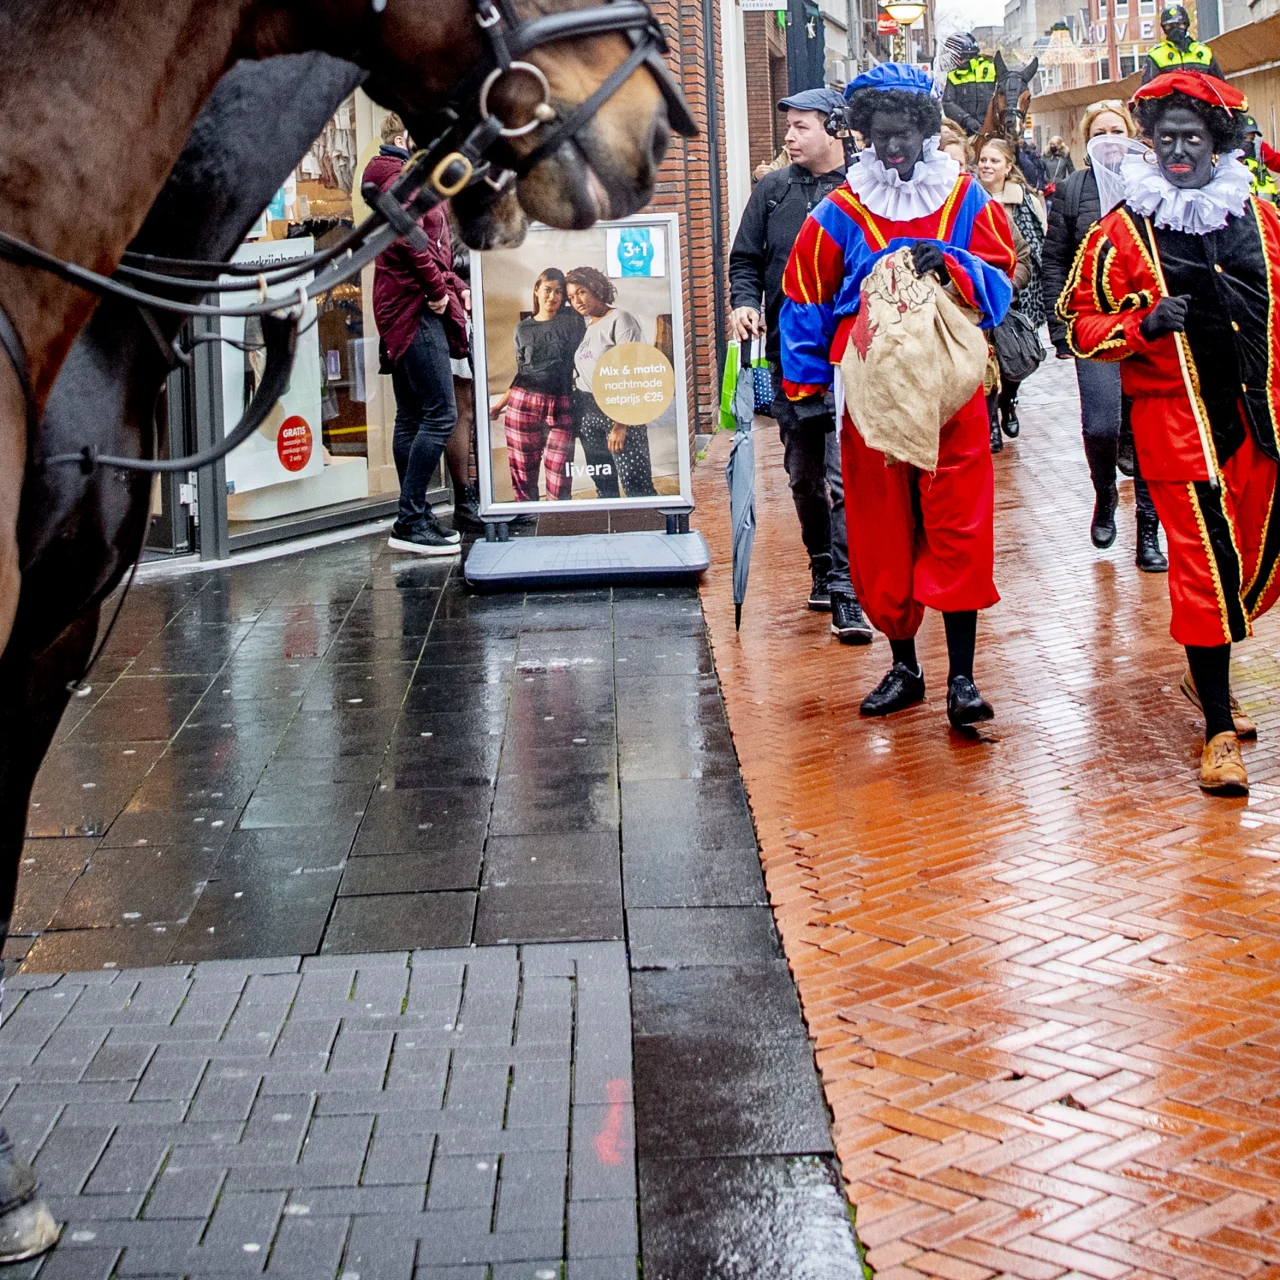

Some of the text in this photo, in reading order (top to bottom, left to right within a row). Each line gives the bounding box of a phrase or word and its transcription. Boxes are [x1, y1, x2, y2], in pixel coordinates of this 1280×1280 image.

[623, 241, 648, 257] 3+1
[599, 363, 667, 376] Mix & match
[604, 377, 663, 390] nachtmode
[605, 391, 664, 406] setprijs €25
[282, 426, 306, 438] GRATIS
[565, 461, 612, 478] livera
